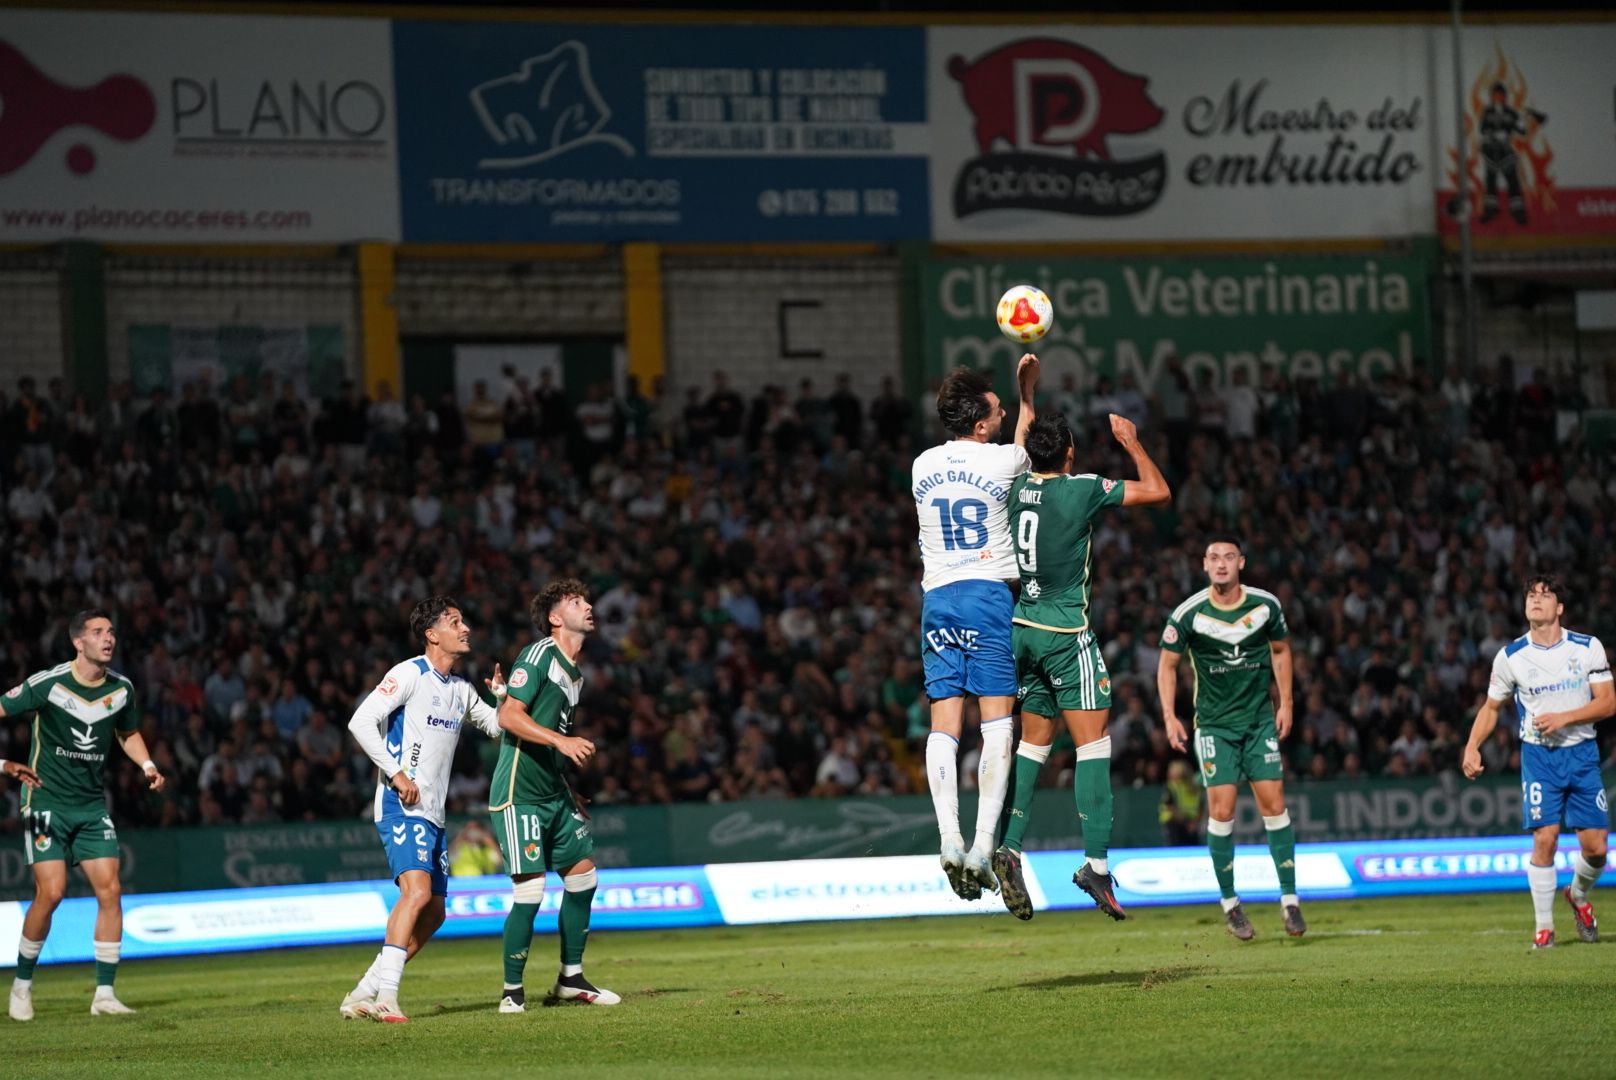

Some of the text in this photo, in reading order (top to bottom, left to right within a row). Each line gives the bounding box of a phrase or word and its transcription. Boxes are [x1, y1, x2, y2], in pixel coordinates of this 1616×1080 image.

[171, 77, 386, 138] PLANO
[1183, 78, 1422, 136] Maestro del
[1186, 135, 1421, 187] embutido
[432, 177, 682, 205] TRANSFORMADOS
[965, 166, 1073, 203] Patricio
[1122, 261, 1410, 316] Veterinaria
[915, 470, 1008, 504] ENRIC GALLEGO
[930, 498, 989, 550] 18
[1017, 510, 1039, 572] 9
[55, 746, 105, 762] Extremadura
[410, 742, 422, 767] CRUZ
[1201, 735, 1216, 759] 15
[1529, 781, 1543, 806] 6
[33, 810, 51, 835] 17
[413, 823, 427, 846] 2
[520, 814, 541, 841] 18
